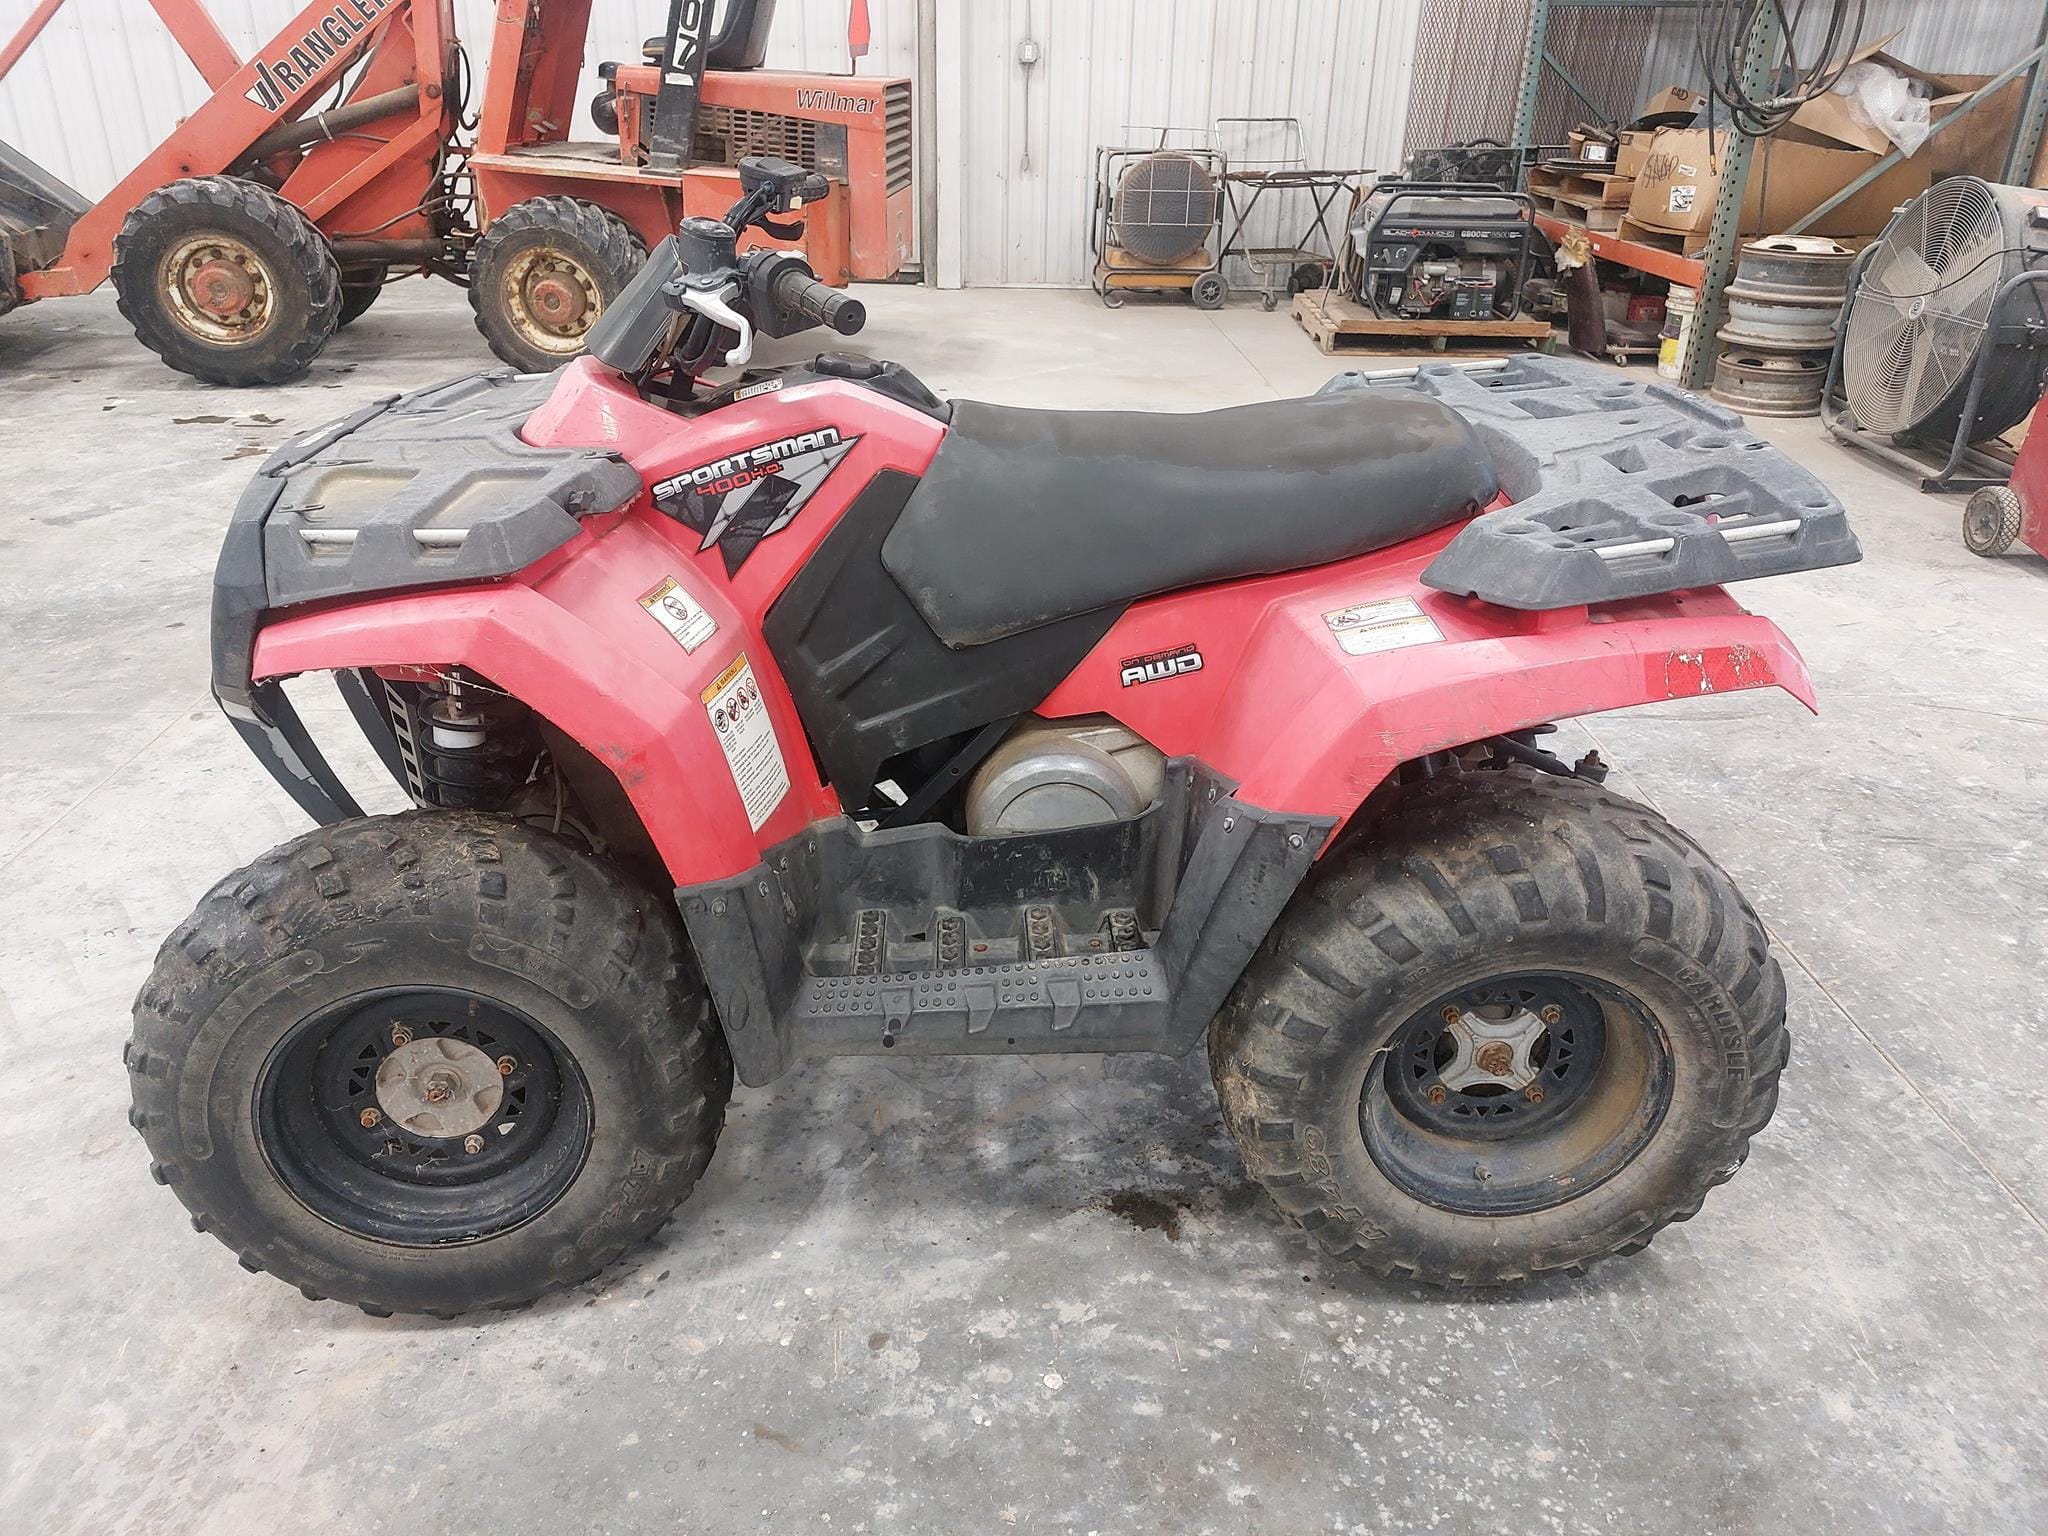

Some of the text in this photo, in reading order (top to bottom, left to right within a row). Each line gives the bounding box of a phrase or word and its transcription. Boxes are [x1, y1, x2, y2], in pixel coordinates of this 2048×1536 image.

[244, 0, 394, 112] WRANGLE
[797, 88, 879, 113] Willmar
[653, 428, 838, 501] SPORTSMAN
[696, 471, 751, 496] 400
[1121, 653, 1203, 687] AWD
[1144, 645, 1195, 662] DEMAND
[1675, 966, 1747, 1081] CARLISLE
